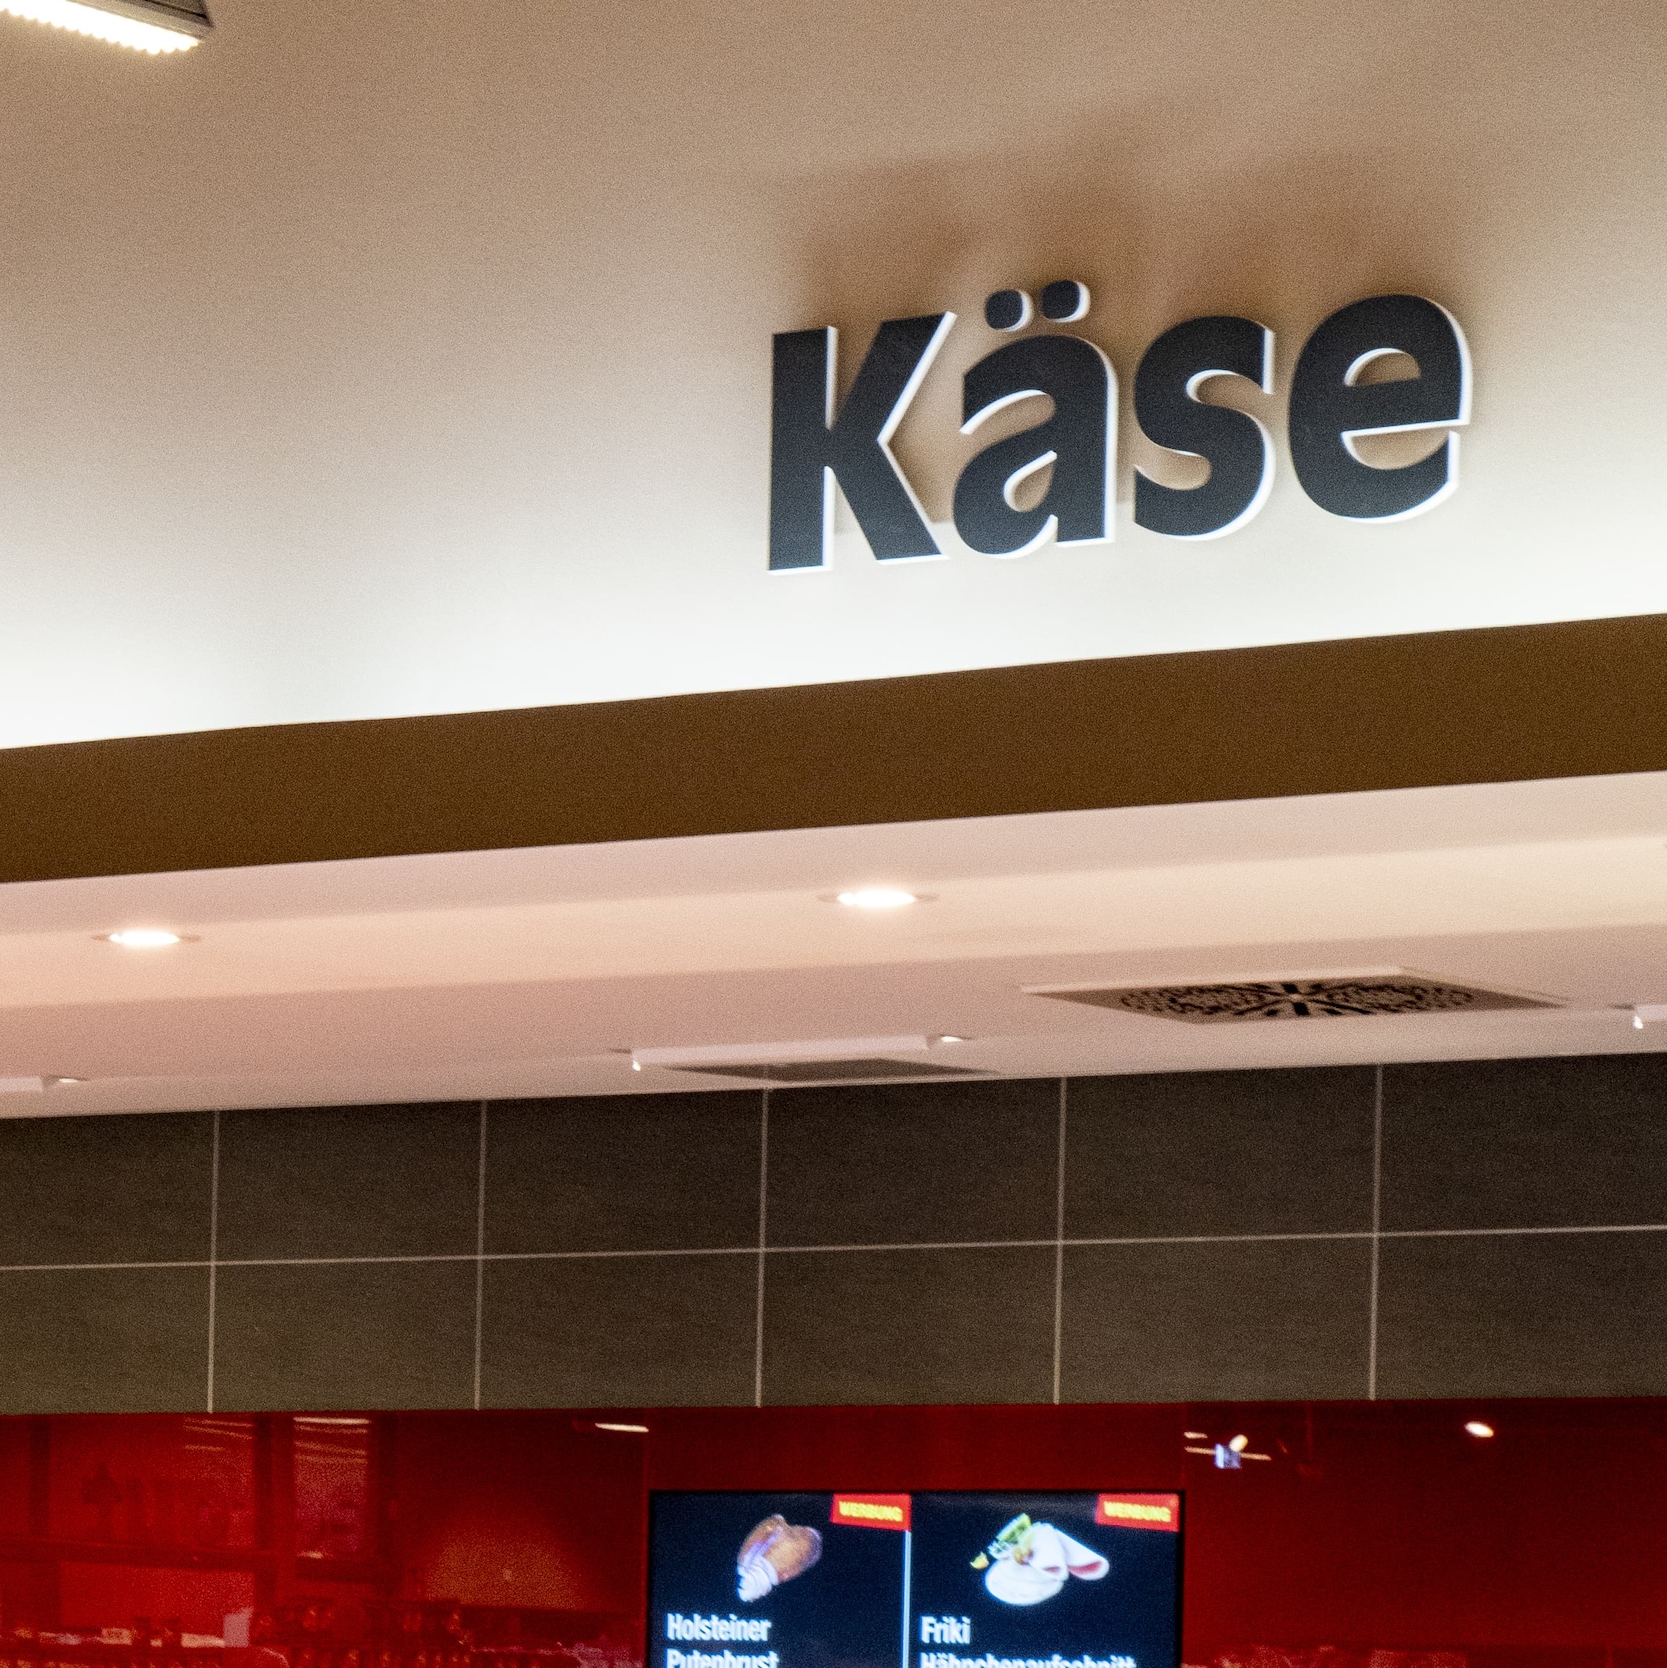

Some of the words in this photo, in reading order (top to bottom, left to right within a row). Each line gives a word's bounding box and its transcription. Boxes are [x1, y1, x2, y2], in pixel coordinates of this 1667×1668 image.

[768, 280, 1471, 575] Käse
[838, 1500, 903, 1523] WERBUNG
[1104, 1500, 1172, 1524] WERBUNG
[666, 1613, 772, 1643] Holsteiner
[920, 1616, 971, 1646] Friki
